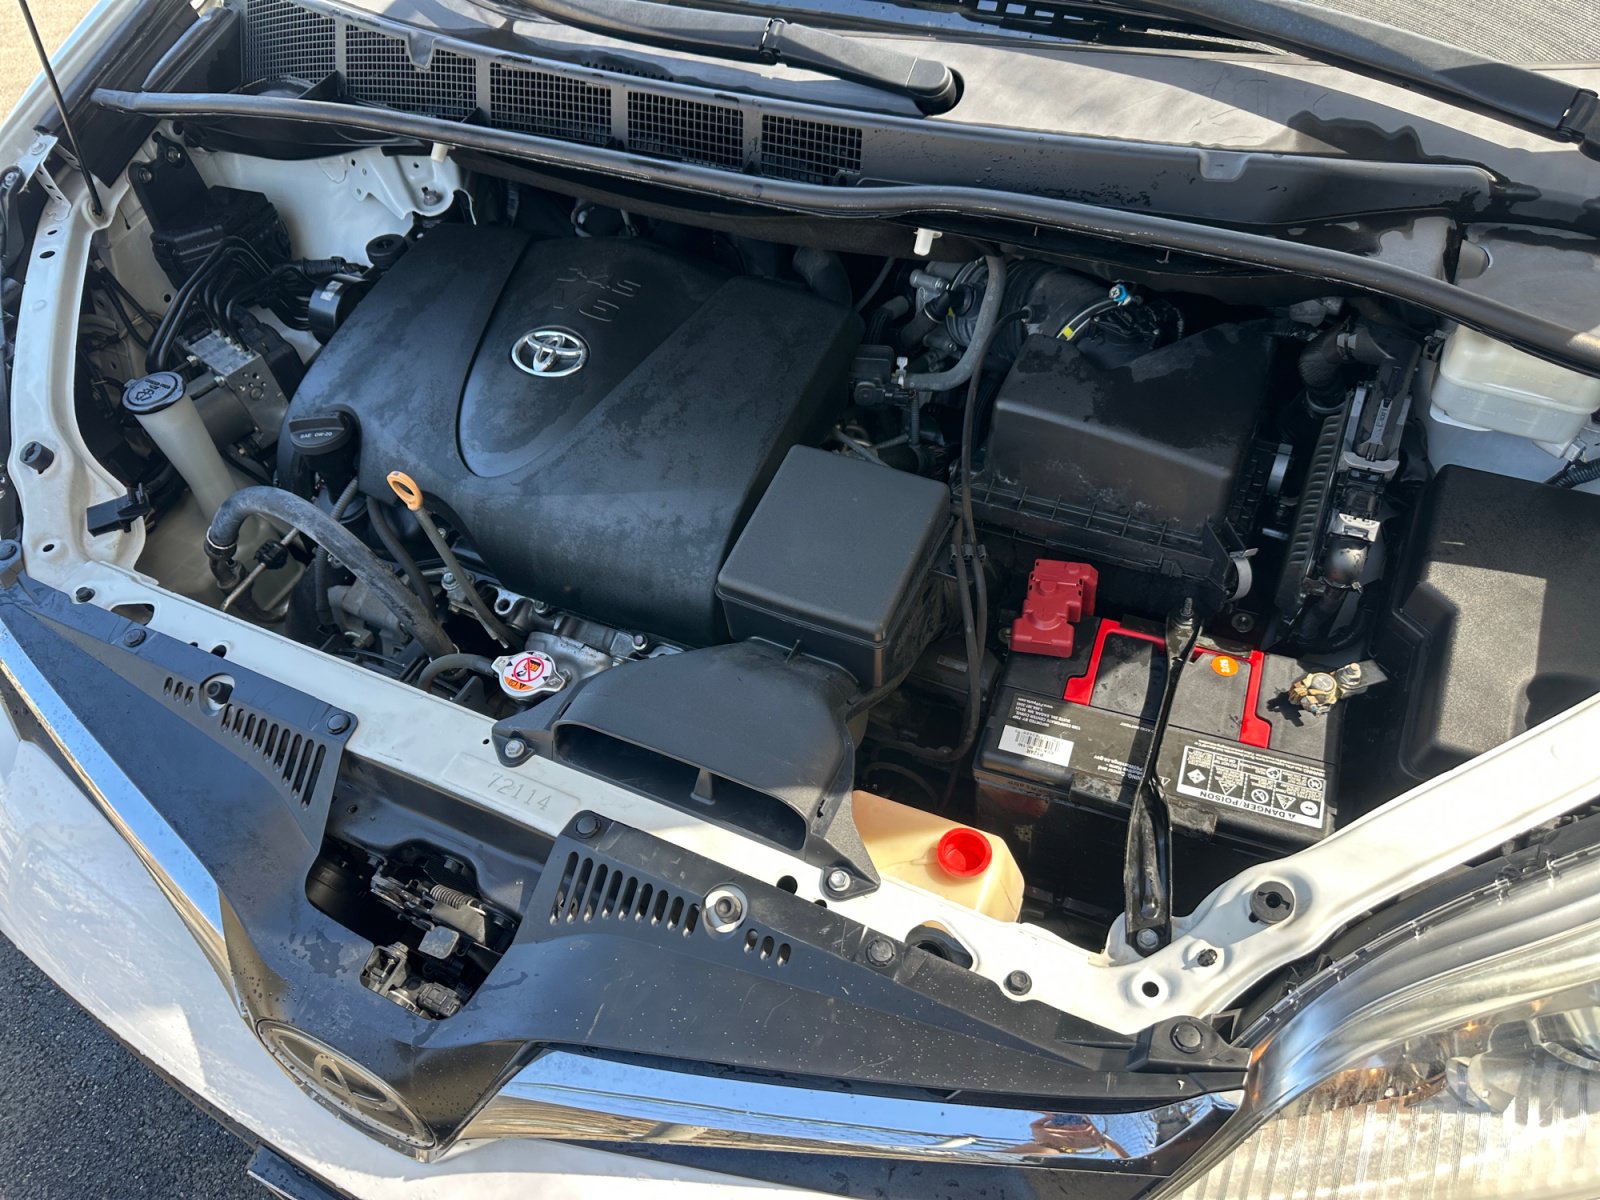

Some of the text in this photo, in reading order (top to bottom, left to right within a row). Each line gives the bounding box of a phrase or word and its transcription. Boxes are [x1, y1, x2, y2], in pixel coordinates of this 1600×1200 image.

[553, 288, 620, 322] V6
[487, 772, 553, 811] 72114
[1199, 790, 1285, 817] DANGER/POISON
